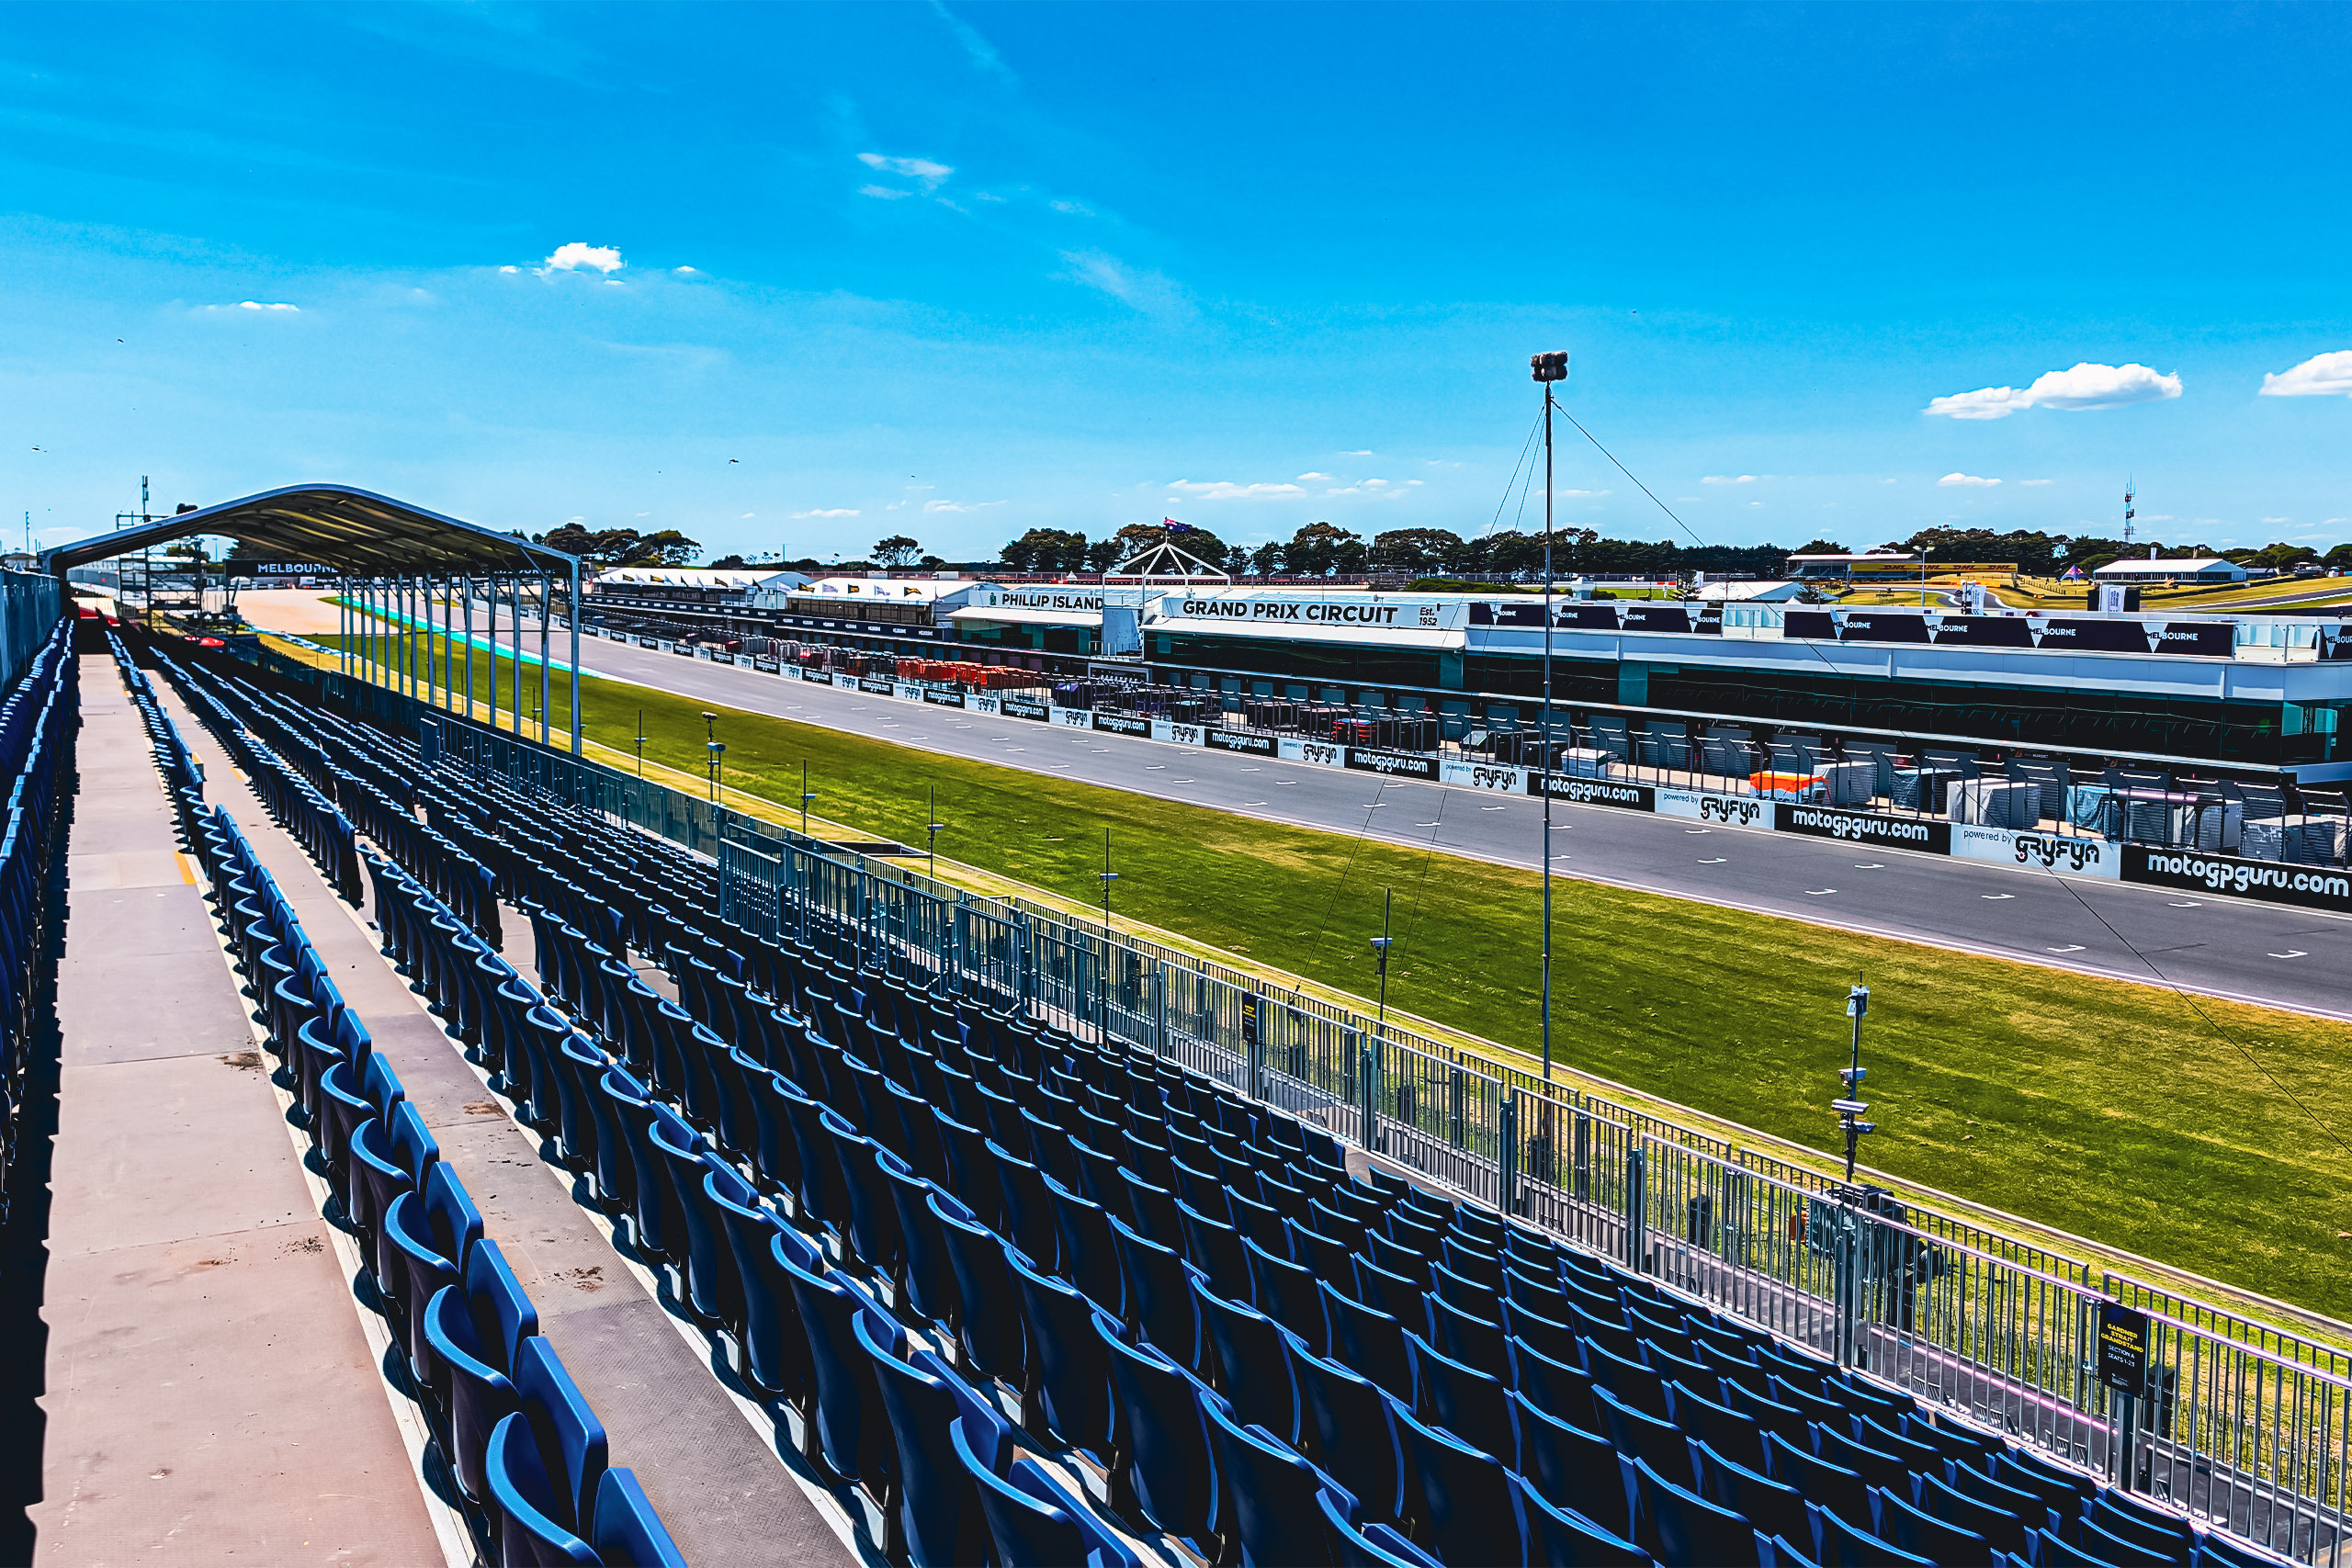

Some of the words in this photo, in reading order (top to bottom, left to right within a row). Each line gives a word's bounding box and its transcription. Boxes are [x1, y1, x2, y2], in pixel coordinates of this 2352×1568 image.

[257, 563, 339, 573] MELBOURNE
[1001, 593, 1050, 607] PHILLIP
[1052, 595, 1102, 610] ISLAND
[1182, 600, 1248, 617] GRAND
[1253, 603, 1301, 620] PRIX
[1306, 604, 1398, 624] CIRCUIT
[1419, 606, 1436, 616] Est.
[1419, 616, 1438, 626] 1952
[1927, 624, 1969, 633] MELBOURNE
[2030, 627, 2076, 637] MELBOURNE
[2146, 631, 2199, 641] MELBOURNE
[1098, 716, 1146, 732] motogpguru.com
[1212, 731, 1270, 750] motogpguru.com
[1354, 751, 1429, 773] motogpguru.com
[1445, 763, 1465, 772] powered
[1541, 777, 1640, 803] motogpguru.com
[1663, 793, 1690, 803] powered
[1690, 795, 1699, 805] by
[1792, 809, 1929, 841] motogpguru.com
[1963, 829, 2000, 841] powered
[2000, 832, 2012, 844] by
[2147, 852, 2350, 897] motogpguru.com
[2107, 1323, 2138, 1339] GARDNER
[2110, 1330, 2133, 1343] STRAIT
[2100, 1332, 2144, 1353] GRANDSTAND
[2108, 1344, 2131, 1358] SECTION
[2108, 1352, 2124, 1363] SEATS
